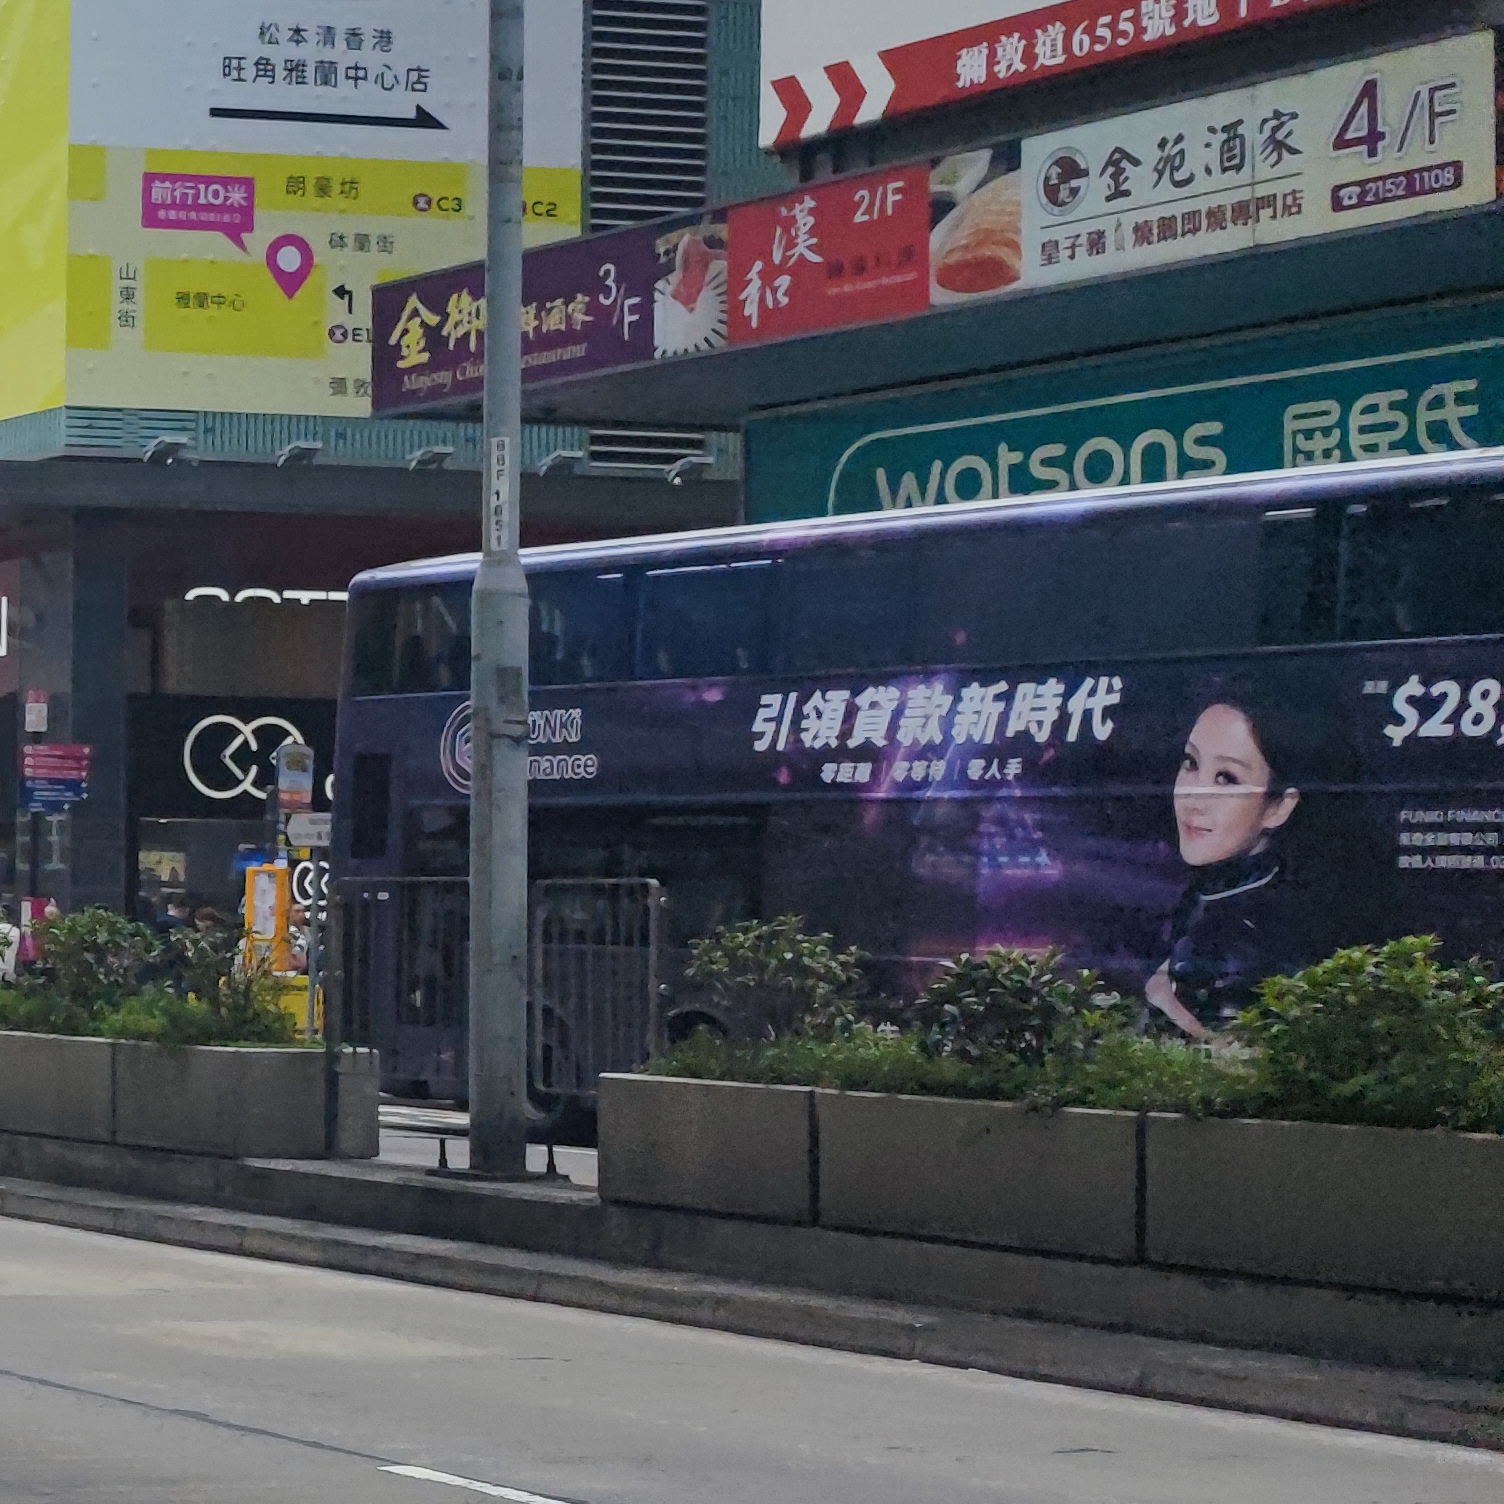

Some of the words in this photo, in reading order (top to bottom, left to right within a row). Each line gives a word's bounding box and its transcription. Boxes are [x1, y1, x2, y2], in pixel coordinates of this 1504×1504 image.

[258, 21, 393, 53] 松本清香港
[222, 55, 431, 93] 旺角雅蘭中心店
[1100, 108, 1303, 203] 金苑酒家
[1332, 76, 1460, 160] 4/F
[151, 180, 248, 207] 前行10米
[285, 174, 360, 199] 朗豪坊
[853, 180, 904, 223] 2/F
[1366, 178, 1407, 203] 2152
[1413, 169, 1455, 194] 1108
[437, 197, 463, 213] C3
[531, 201, 558, 217] C2
[118, 263, 138, 329] 山東街
[598, 262, 641, 341] 3/F
[521, 341, 588, 371] estaurant
[750, 677, 1123, 753] 引領貸款新時代
